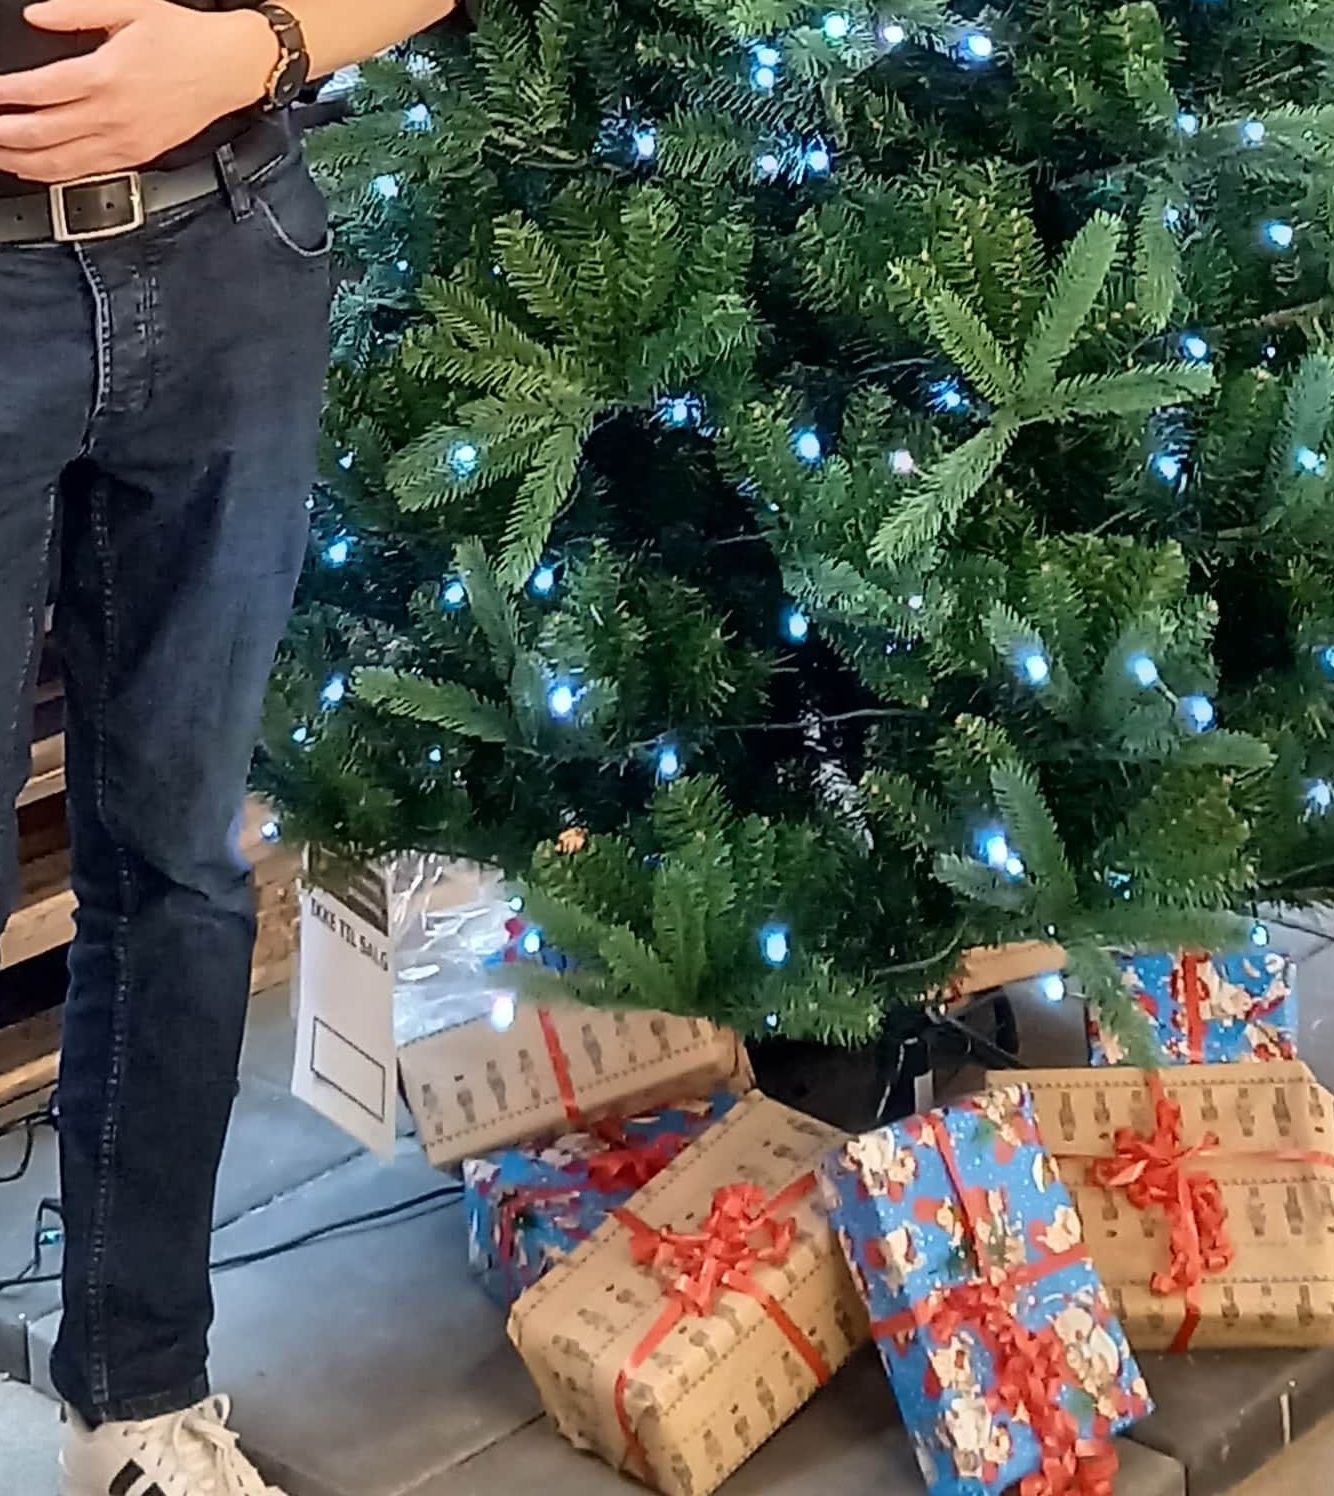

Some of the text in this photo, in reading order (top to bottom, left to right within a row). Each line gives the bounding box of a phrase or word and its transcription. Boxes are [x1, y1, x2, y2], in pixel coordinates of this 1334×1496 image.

[310, 897, 389, 973] IKKE TIL SALG
